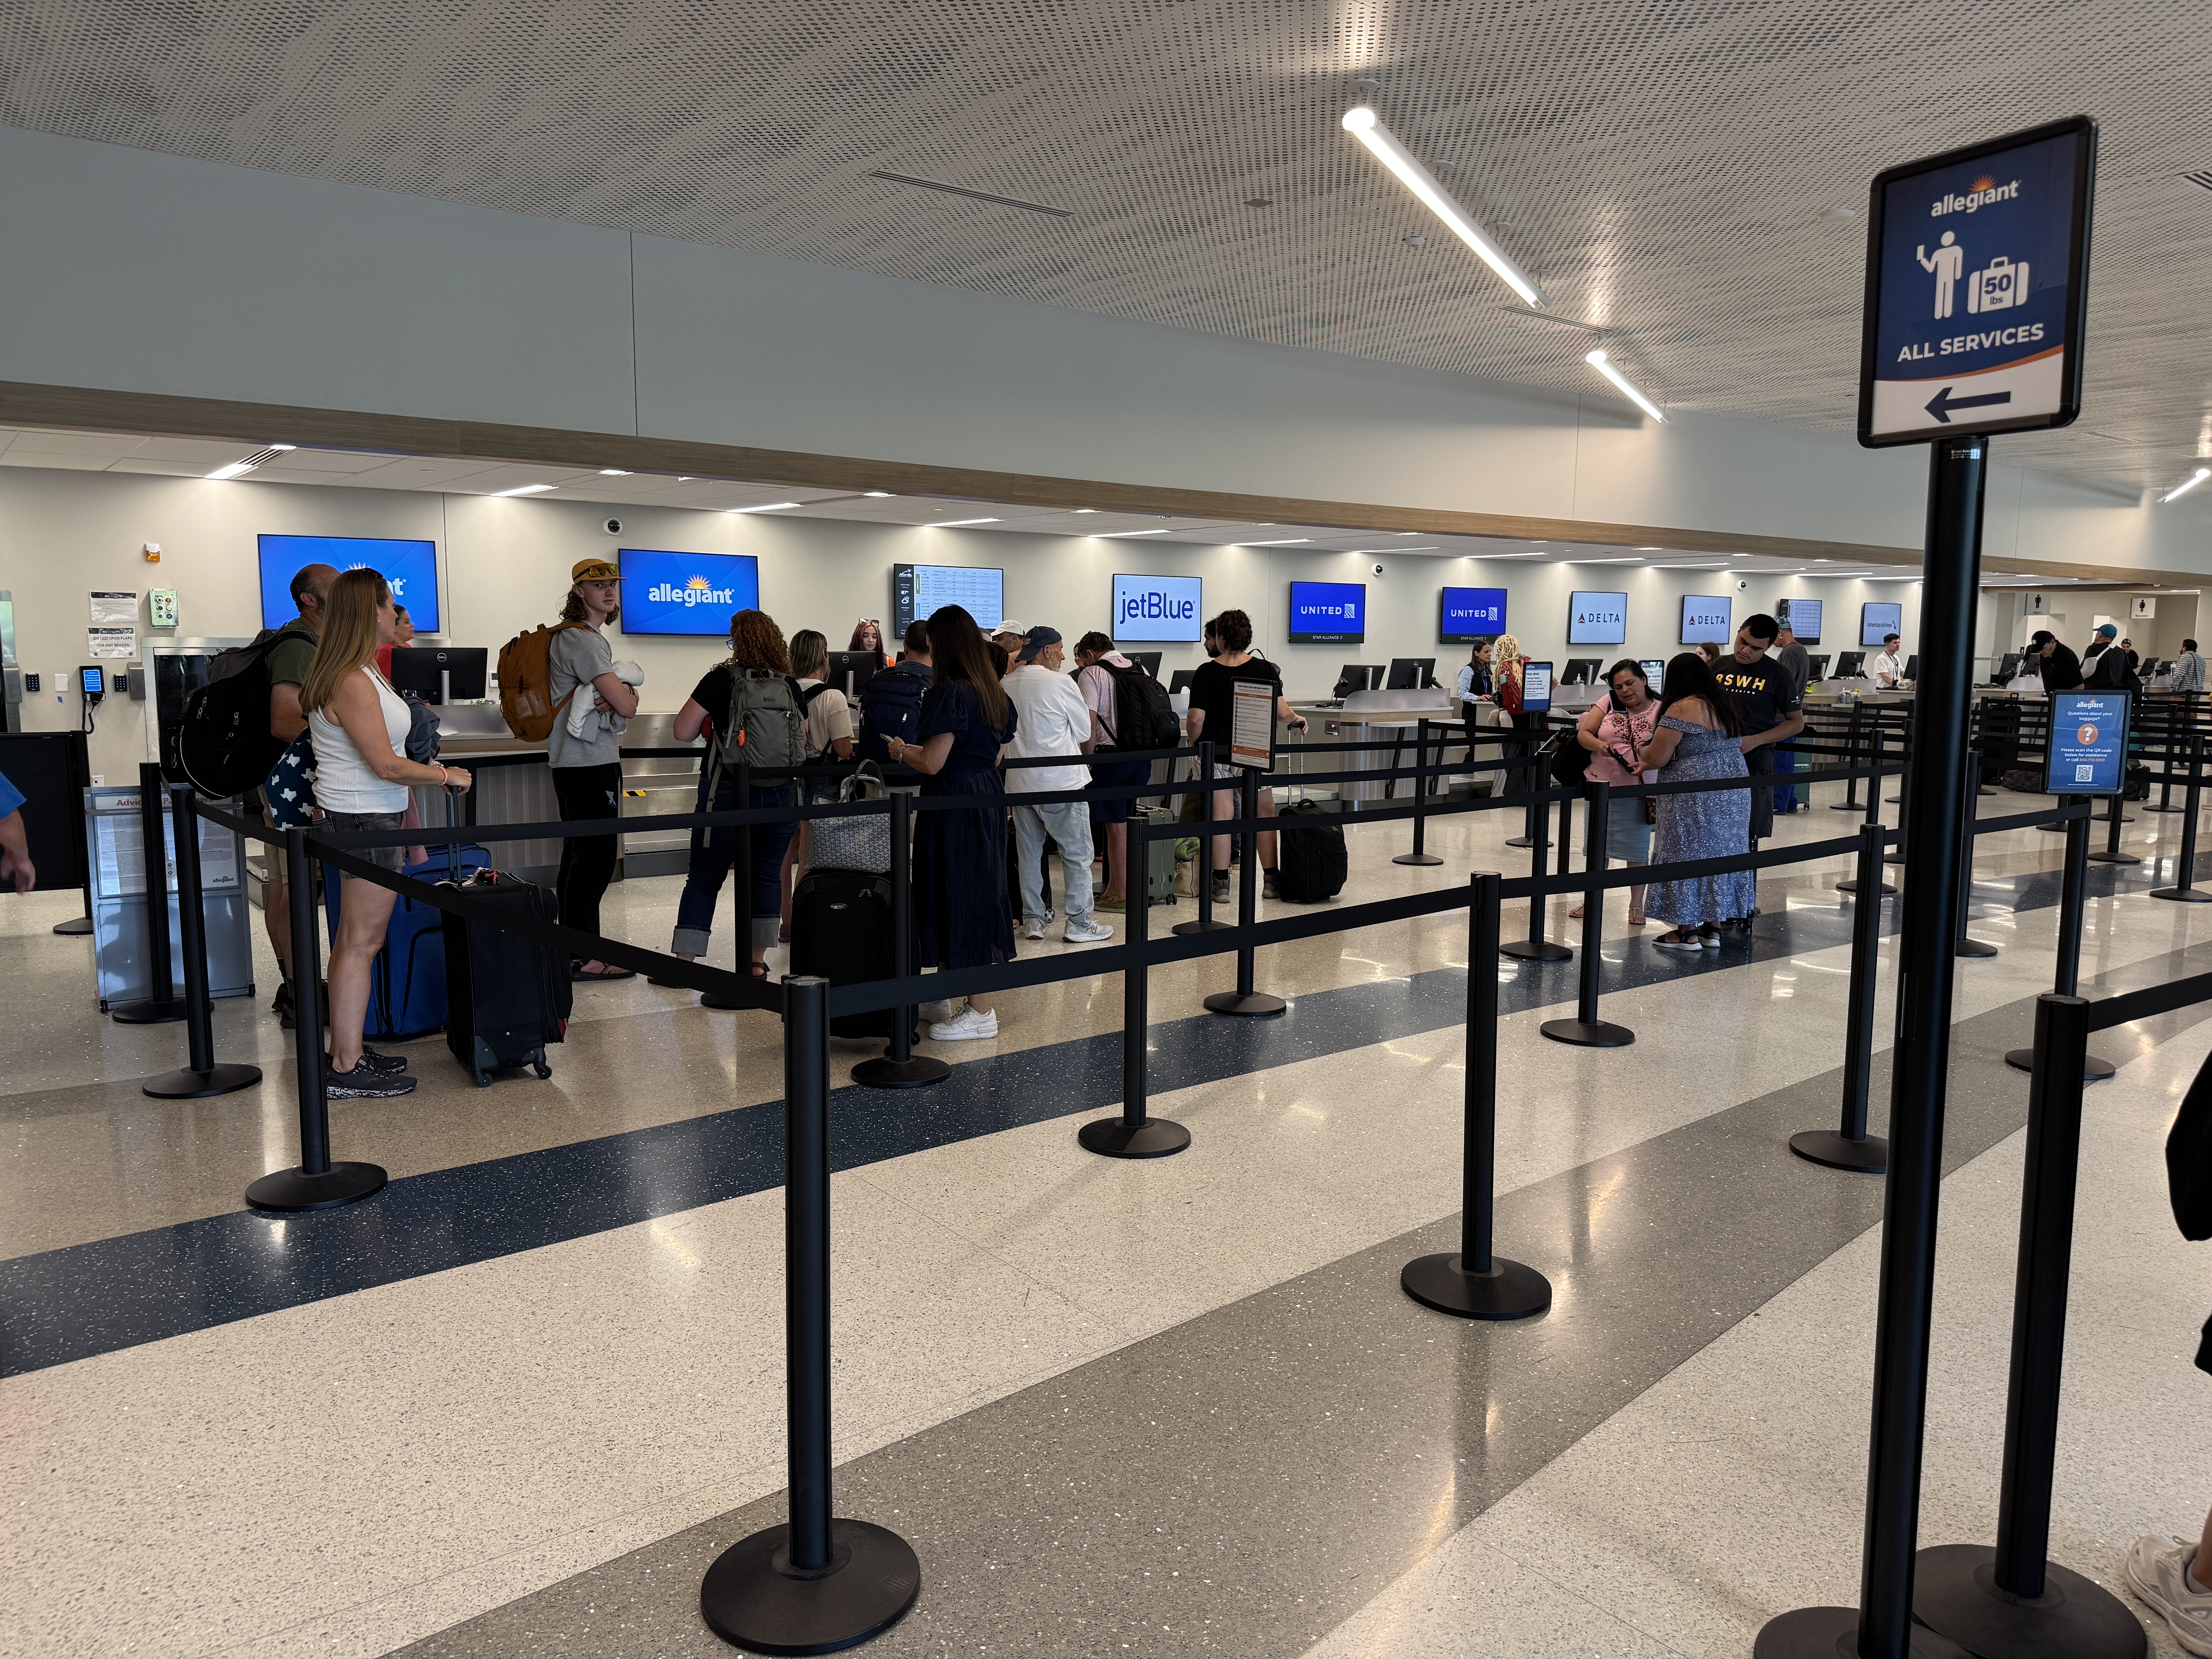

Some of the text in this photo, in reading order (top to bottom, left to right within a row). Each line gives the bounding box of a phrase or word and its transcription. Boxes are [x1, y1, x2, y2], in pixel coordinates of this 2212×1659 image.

[1931, 180, 2019, 217] allegiant
[1984, 274, 2011, 295] 50
[1990, 296, 2003, 305] lbs
[1897, 323, 2044, 362] ALL SERVICES
[648, 583, 732, 607] allegiant
[1120, 591, 1193, 624] jetBlue
[1301, 606, 1342, 615] UNITED
[1451, 609, 1486, 617] UNITED
[1589, 613, 1620, 623] DELTA
[1698, 615, 1725, 625] DELTA
